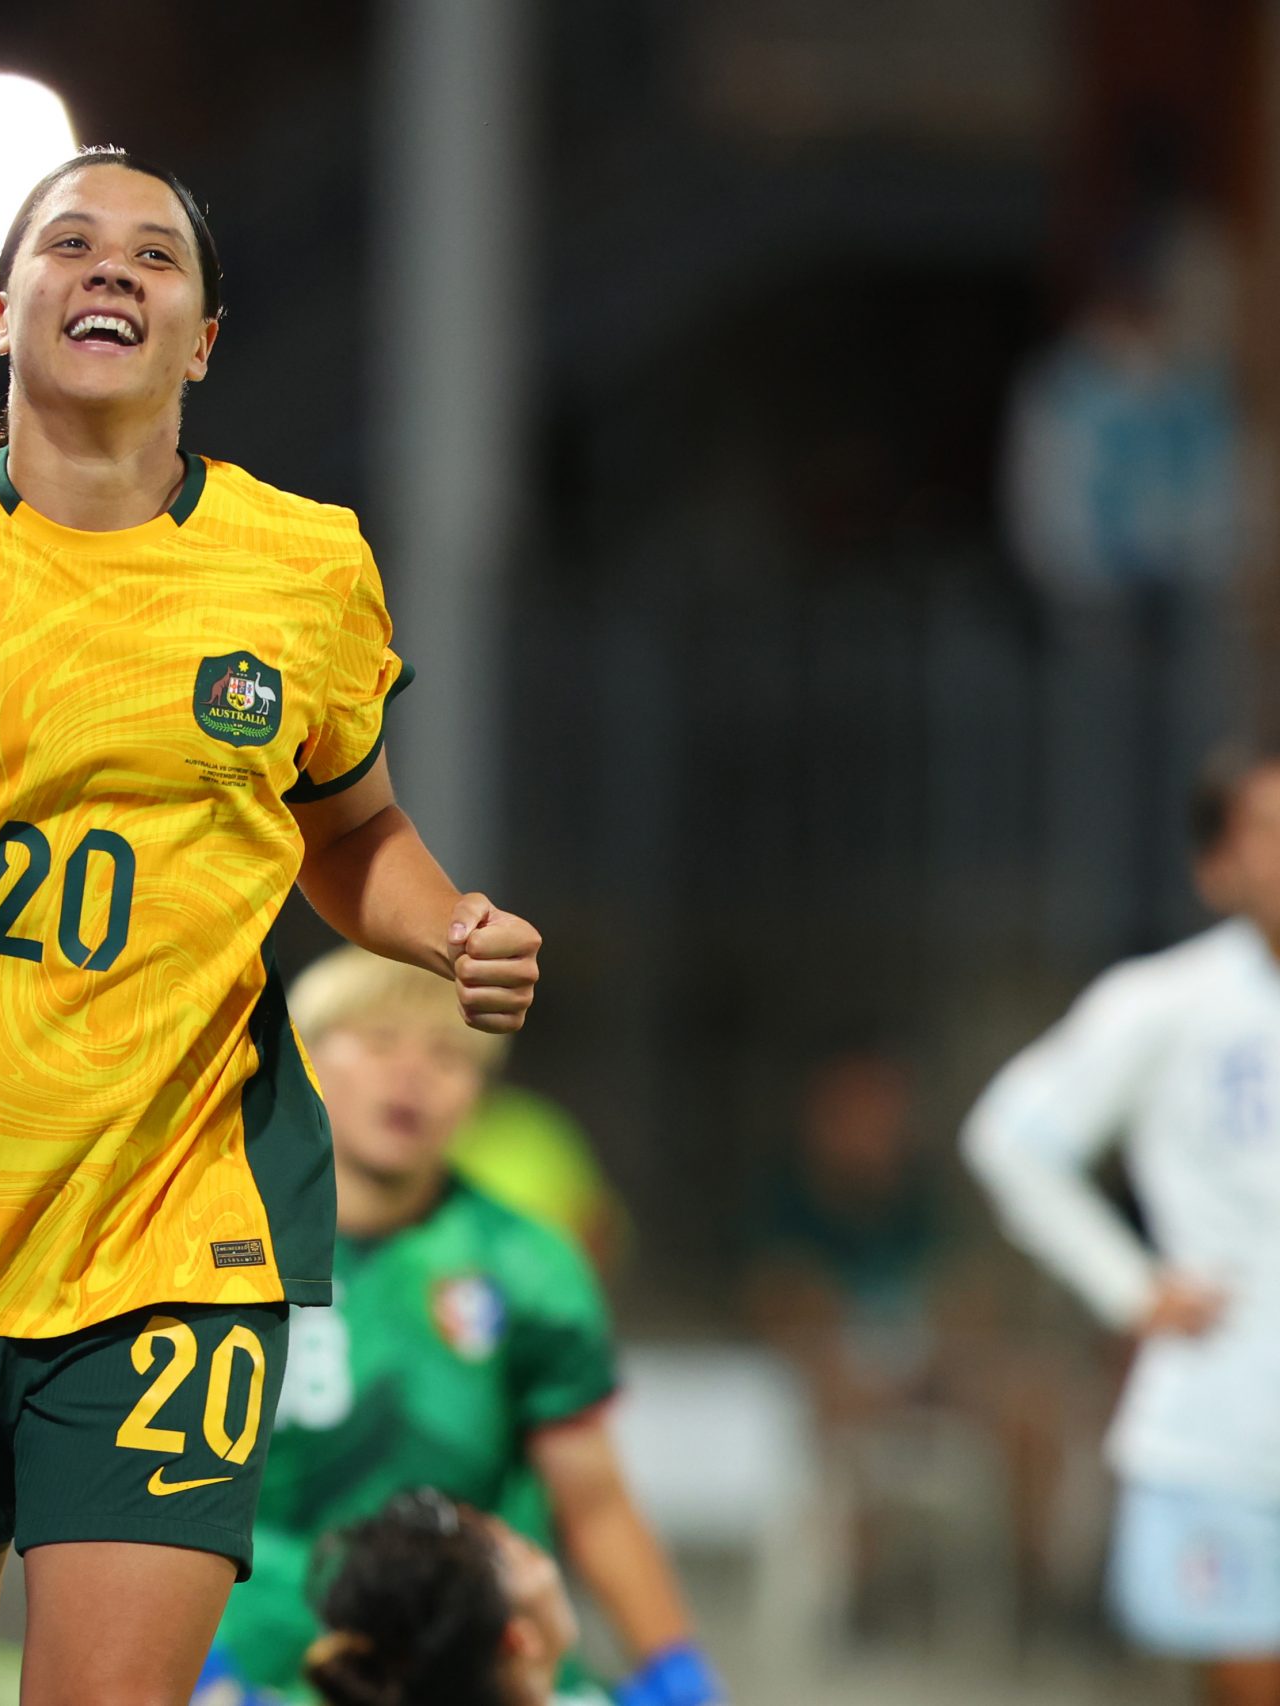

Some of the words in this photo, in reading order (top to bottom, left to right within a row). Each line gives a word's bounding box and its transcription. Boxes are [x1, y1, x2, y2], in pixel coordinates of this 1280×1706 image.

[209, 707, 266, 725] AUSTRALIA
[185, 759, 218, 769] AUSTRALIA
[115, 1315, 266, 1465] 20
